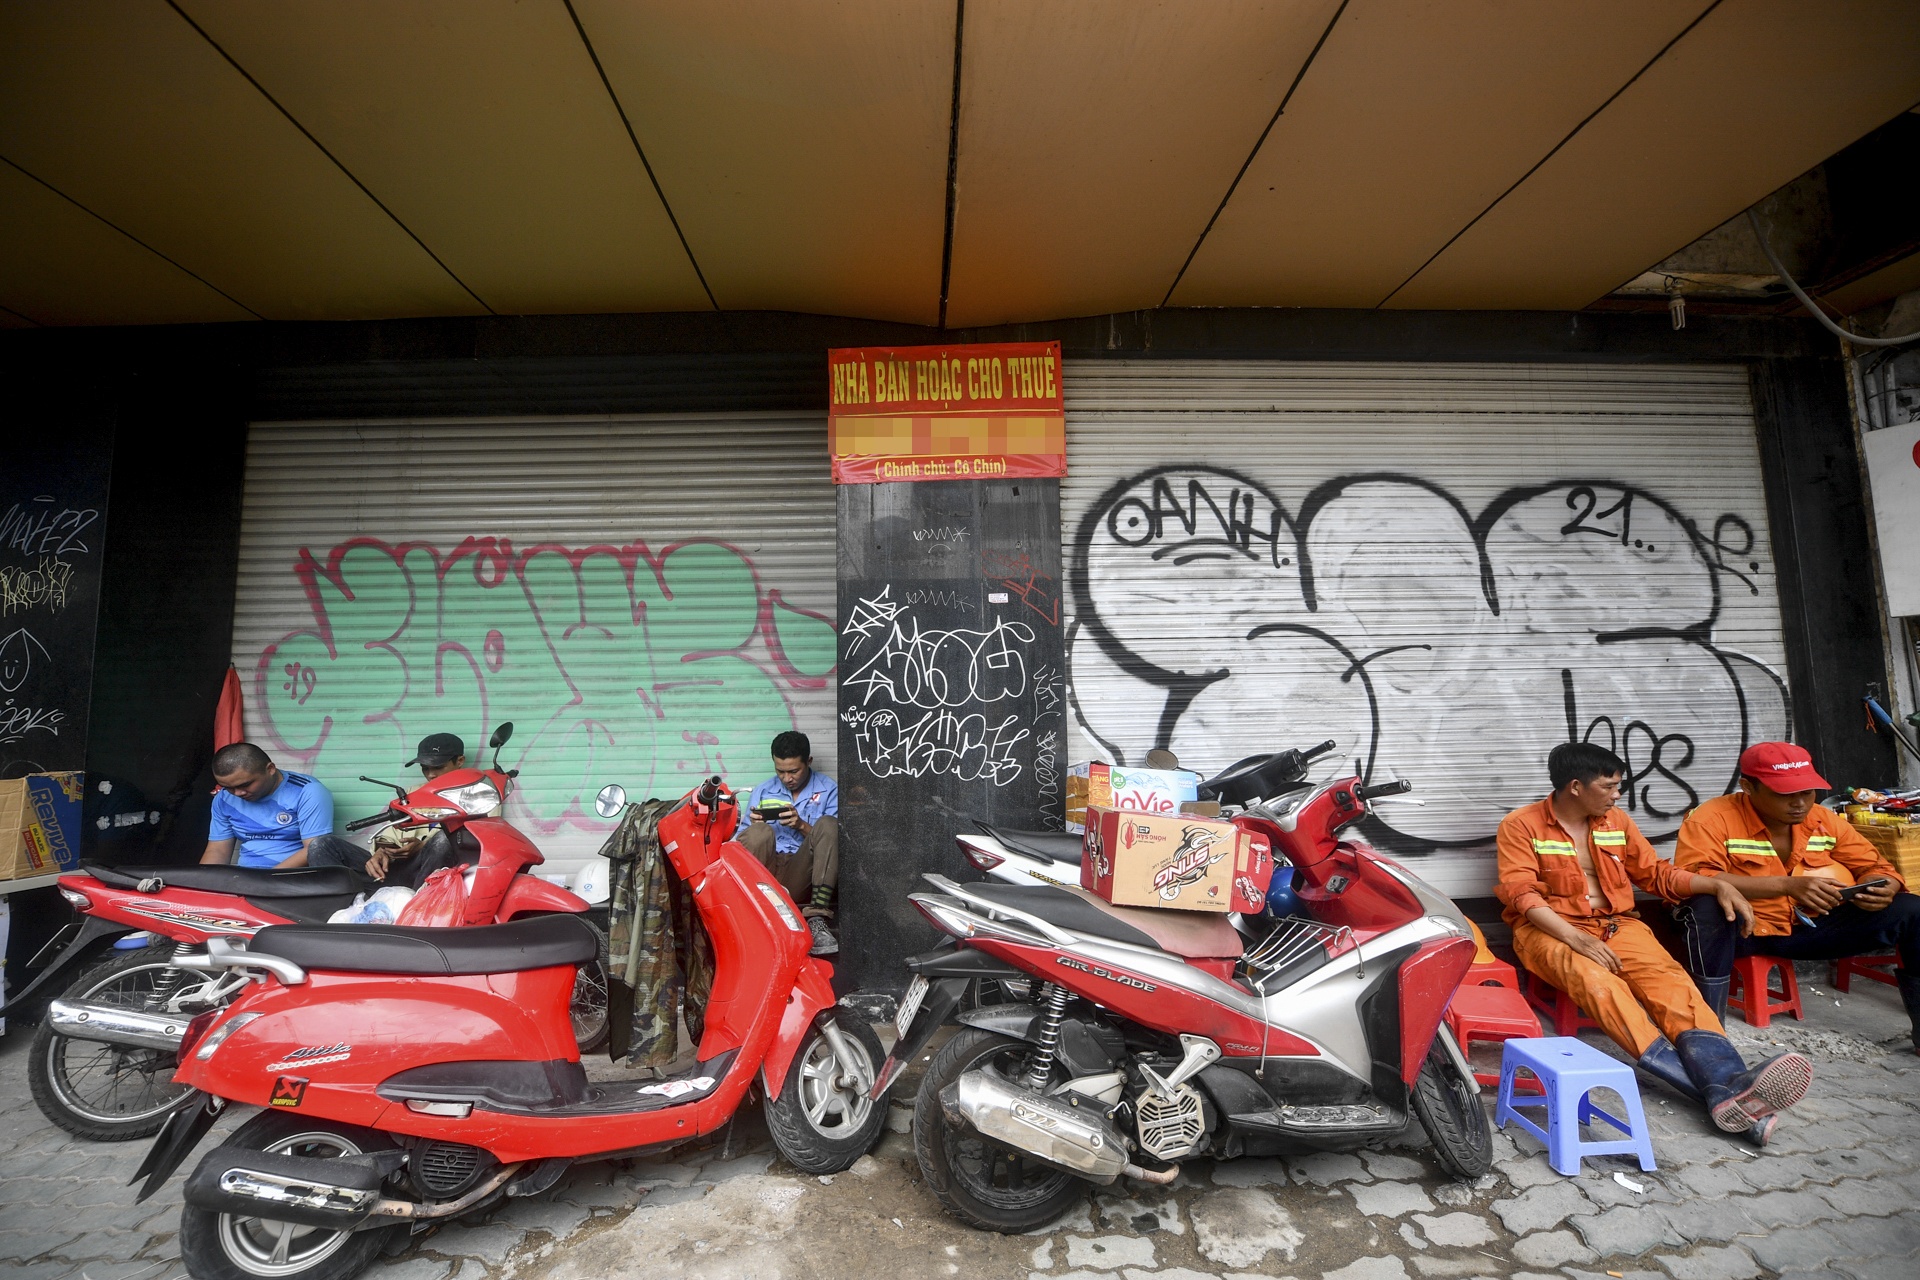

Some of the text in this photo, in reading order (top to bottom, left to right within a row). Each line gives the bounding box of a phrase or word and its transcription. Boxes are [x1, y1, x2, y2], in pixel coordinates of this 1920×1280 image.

[833, 348, 1057, 409] NHÀ BÁN HOẶC CHO THUÊ
[924, 461, 950, 476] chủ:
[954, 459, 970, 475] Cô
[28, 788, 71, 865] Revive
[1153, 843, 1210, 892] STING
[1056, 956, 1157, 993] AIR BLADE
[283, 1042, 351, 1060] Attila
